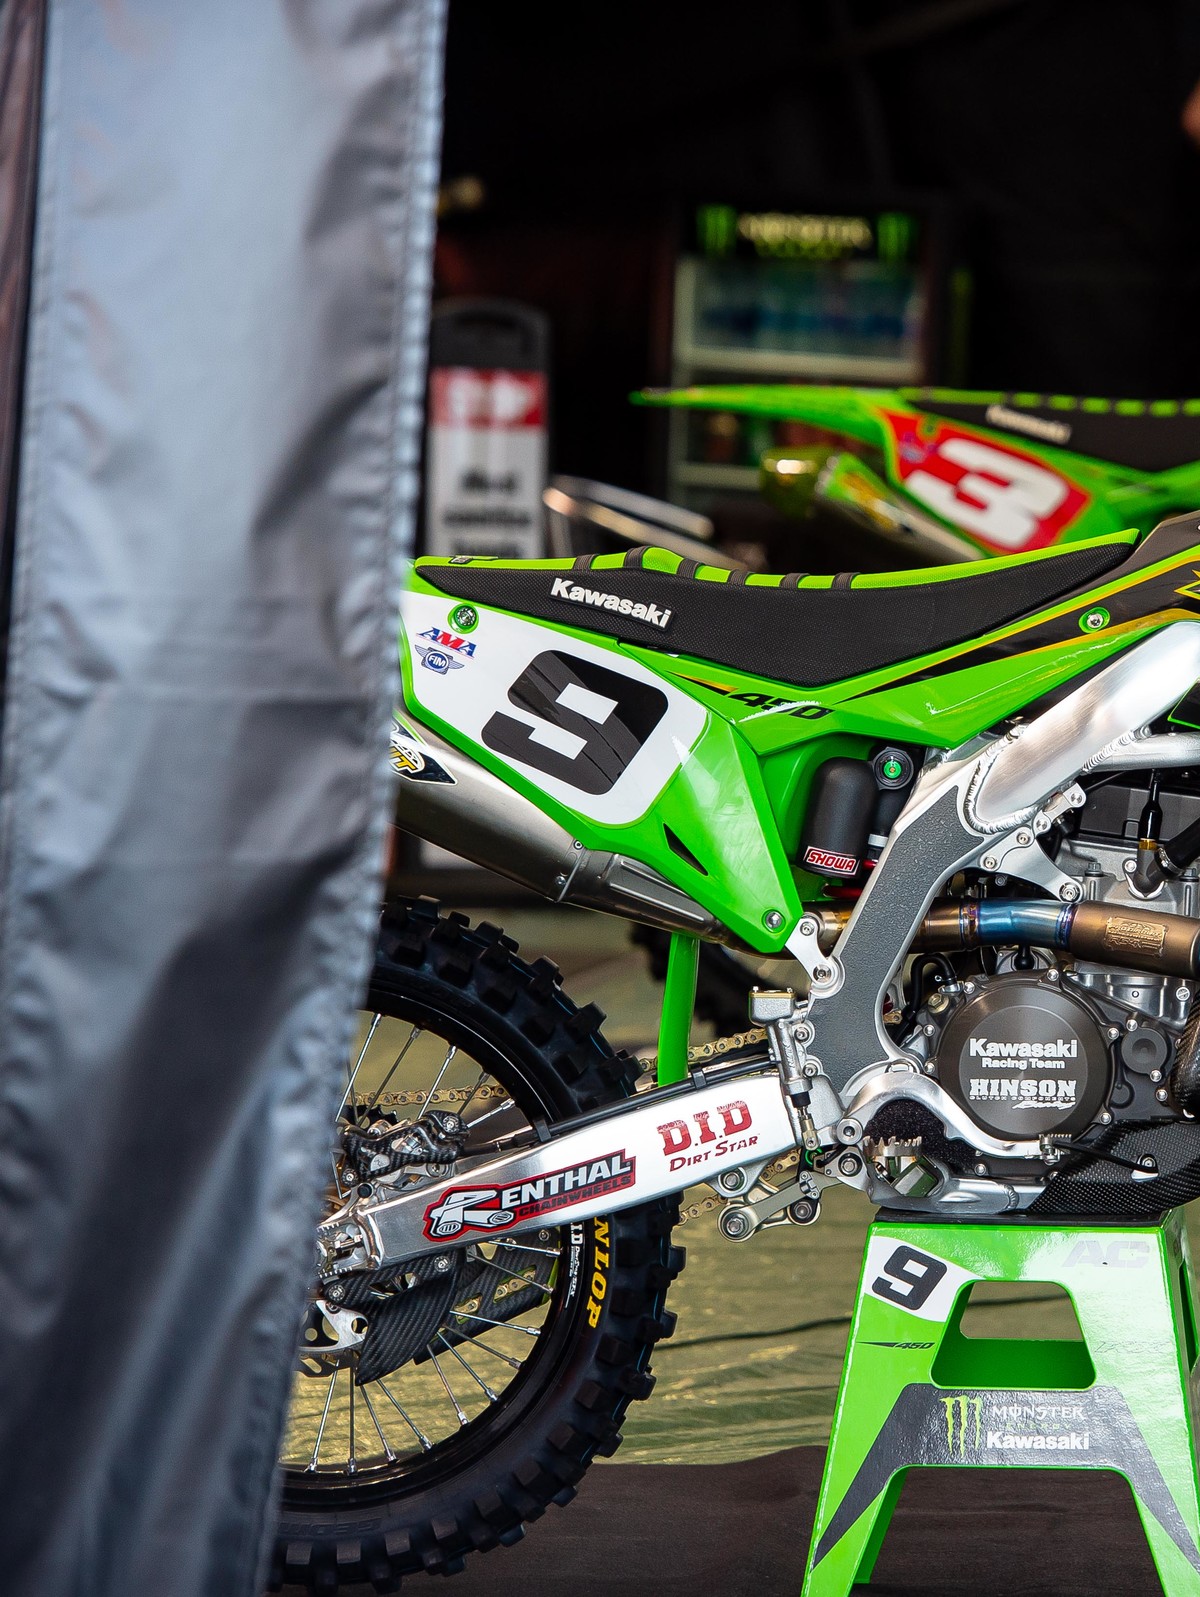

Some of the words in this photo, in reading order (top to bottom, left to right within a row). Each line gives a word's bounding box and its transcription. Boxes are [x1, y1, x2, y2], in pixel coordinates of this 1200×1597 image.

[905, 437, 1069, 550] 3
[550, 577, 672, 629] Kawasaki
[416, 626, 477, 660] AMA
[428, 655, 446, 667] FIM
[481, 650, 668, 795] 9
[806, 850, 857, 872] SHOWA
[969, 1038, 1077, 1058] Kawasaki
[982, 1057, 1028, 1070] Racing
[1029, 1058, 1065, 1069] Team
[969, 1078, 1077, 1097] HINSON
[656, 1100, 753, 1156] D.I.D
[519, 1174, 632, 1217] CHAINWHEELS
[871, 1245, 948, 1311] 9
[895, 1341, 936, 1350] 450
[991, 1404, 1085, 1421] MONSTER
[986, 1430, 1090, 1450] Kawasaki
